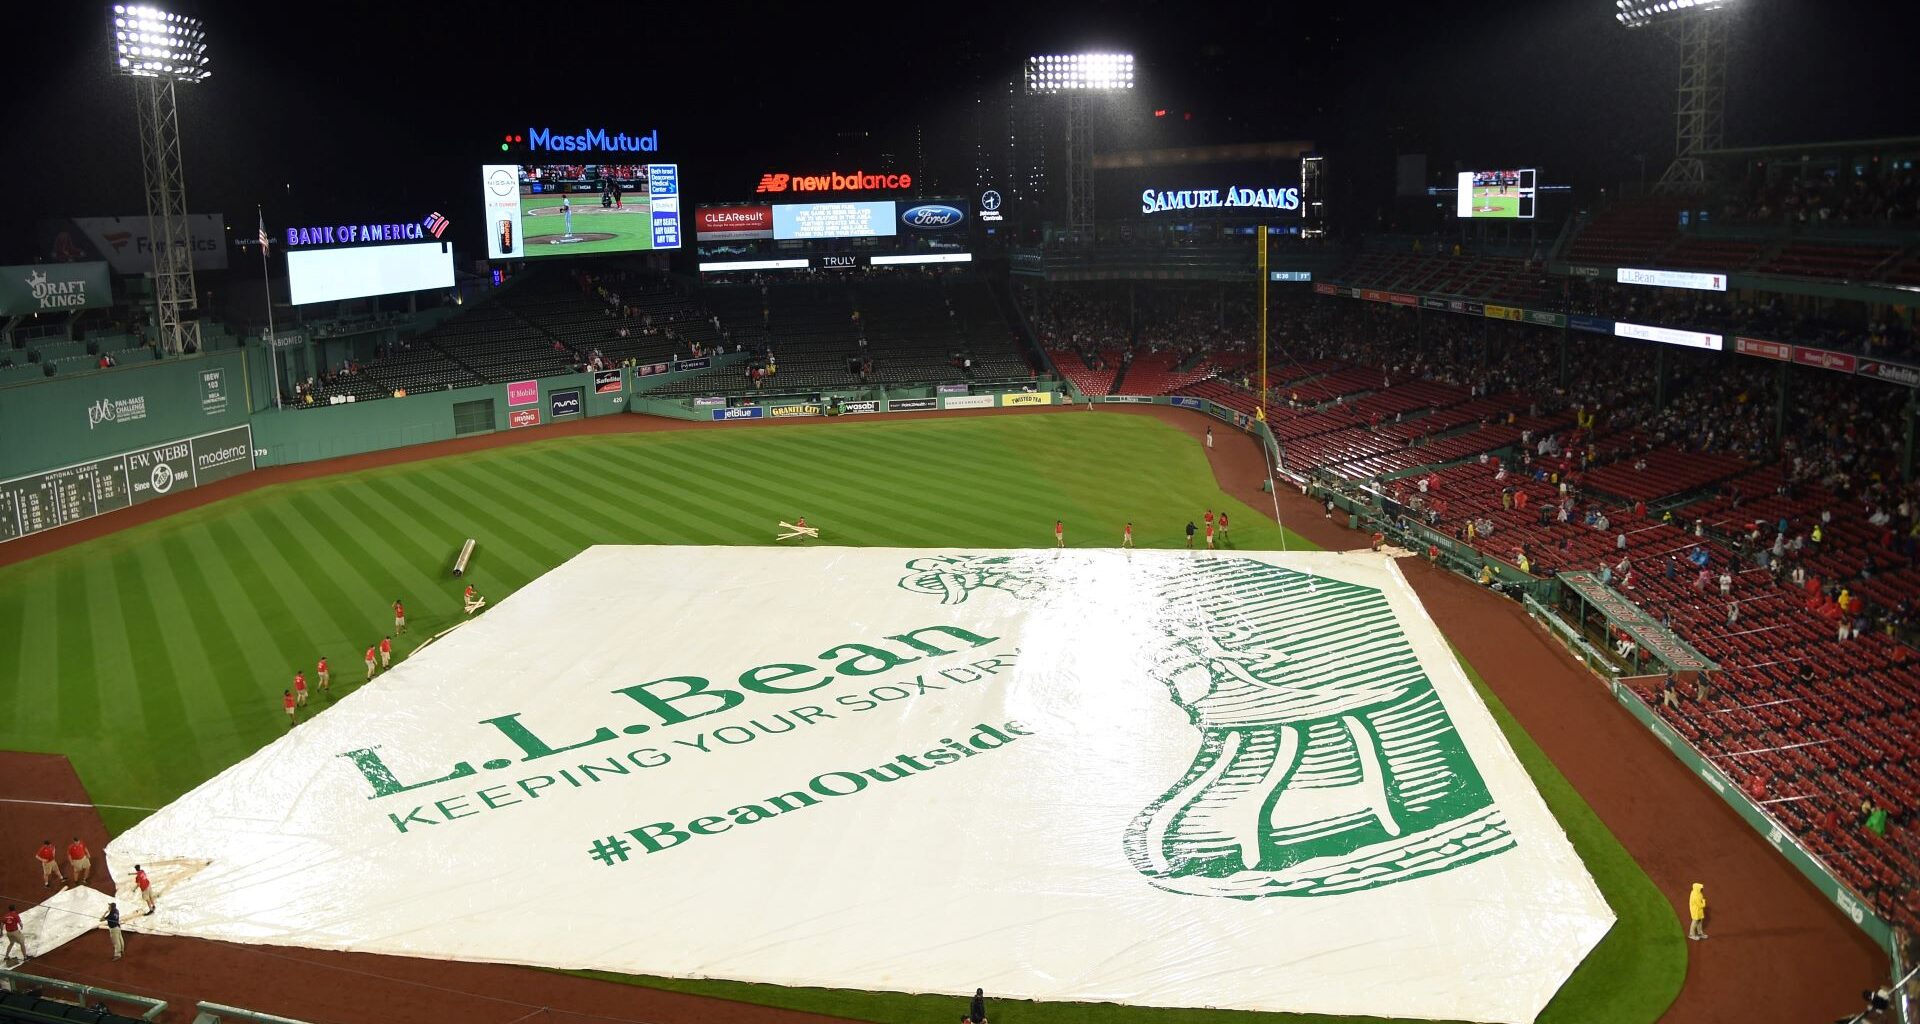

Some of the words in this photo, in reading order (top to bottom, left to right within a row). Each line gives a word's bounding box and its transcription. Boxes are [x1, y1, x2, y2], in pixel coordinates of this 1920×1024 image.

[530, 128, 658, 151] MassMutual
[1142, 189, 1223, 213] SAMUEL
[1224, 186, 1299, 210] ADAMS
[705, 212, 763, 222] CLEAResult
[914, 208, 952, 224] Ford
[287, 226, 335, 246] BANK
[339, 225, 357, 243] OF
[361, 223, 424, 242] AMERICA
[823, 256, 856, 266] TRULY
[32, 280, 86, 299] DRAFT
[40, 293, 86, 308] KINGS
[208, 380, 218, 389] 103
[115, 396, 144, 408] PAN-MASS
[116, 403, 145, 413] CHALLENGE
[554, 399, 578, 408] nuna
[725, 408, 751, 418] jetBlue
[772, 406, 803, 415] GRANITE
[804, 405, 820, 414] CITY
[514, 414, 535, 423] IRVING
[153, 444, 188, 463] WEBB
[198, 444, 246, 466] moderna
[45, 469, 74, 481] NATIONAL
[76, 464, 98, 474] LEAGUE
[134, 481, 150, 492] Since
[335, 626, 1000, 800] L.L.Bean
[387, 748, 672, 834] KEEPING
[674, 706, 838, 753] YOUR
[836, 675, 947, 712] SOX
[938, 647, 1022, 684] DR
[587, 720, 1035, 867] #BeanOutside
